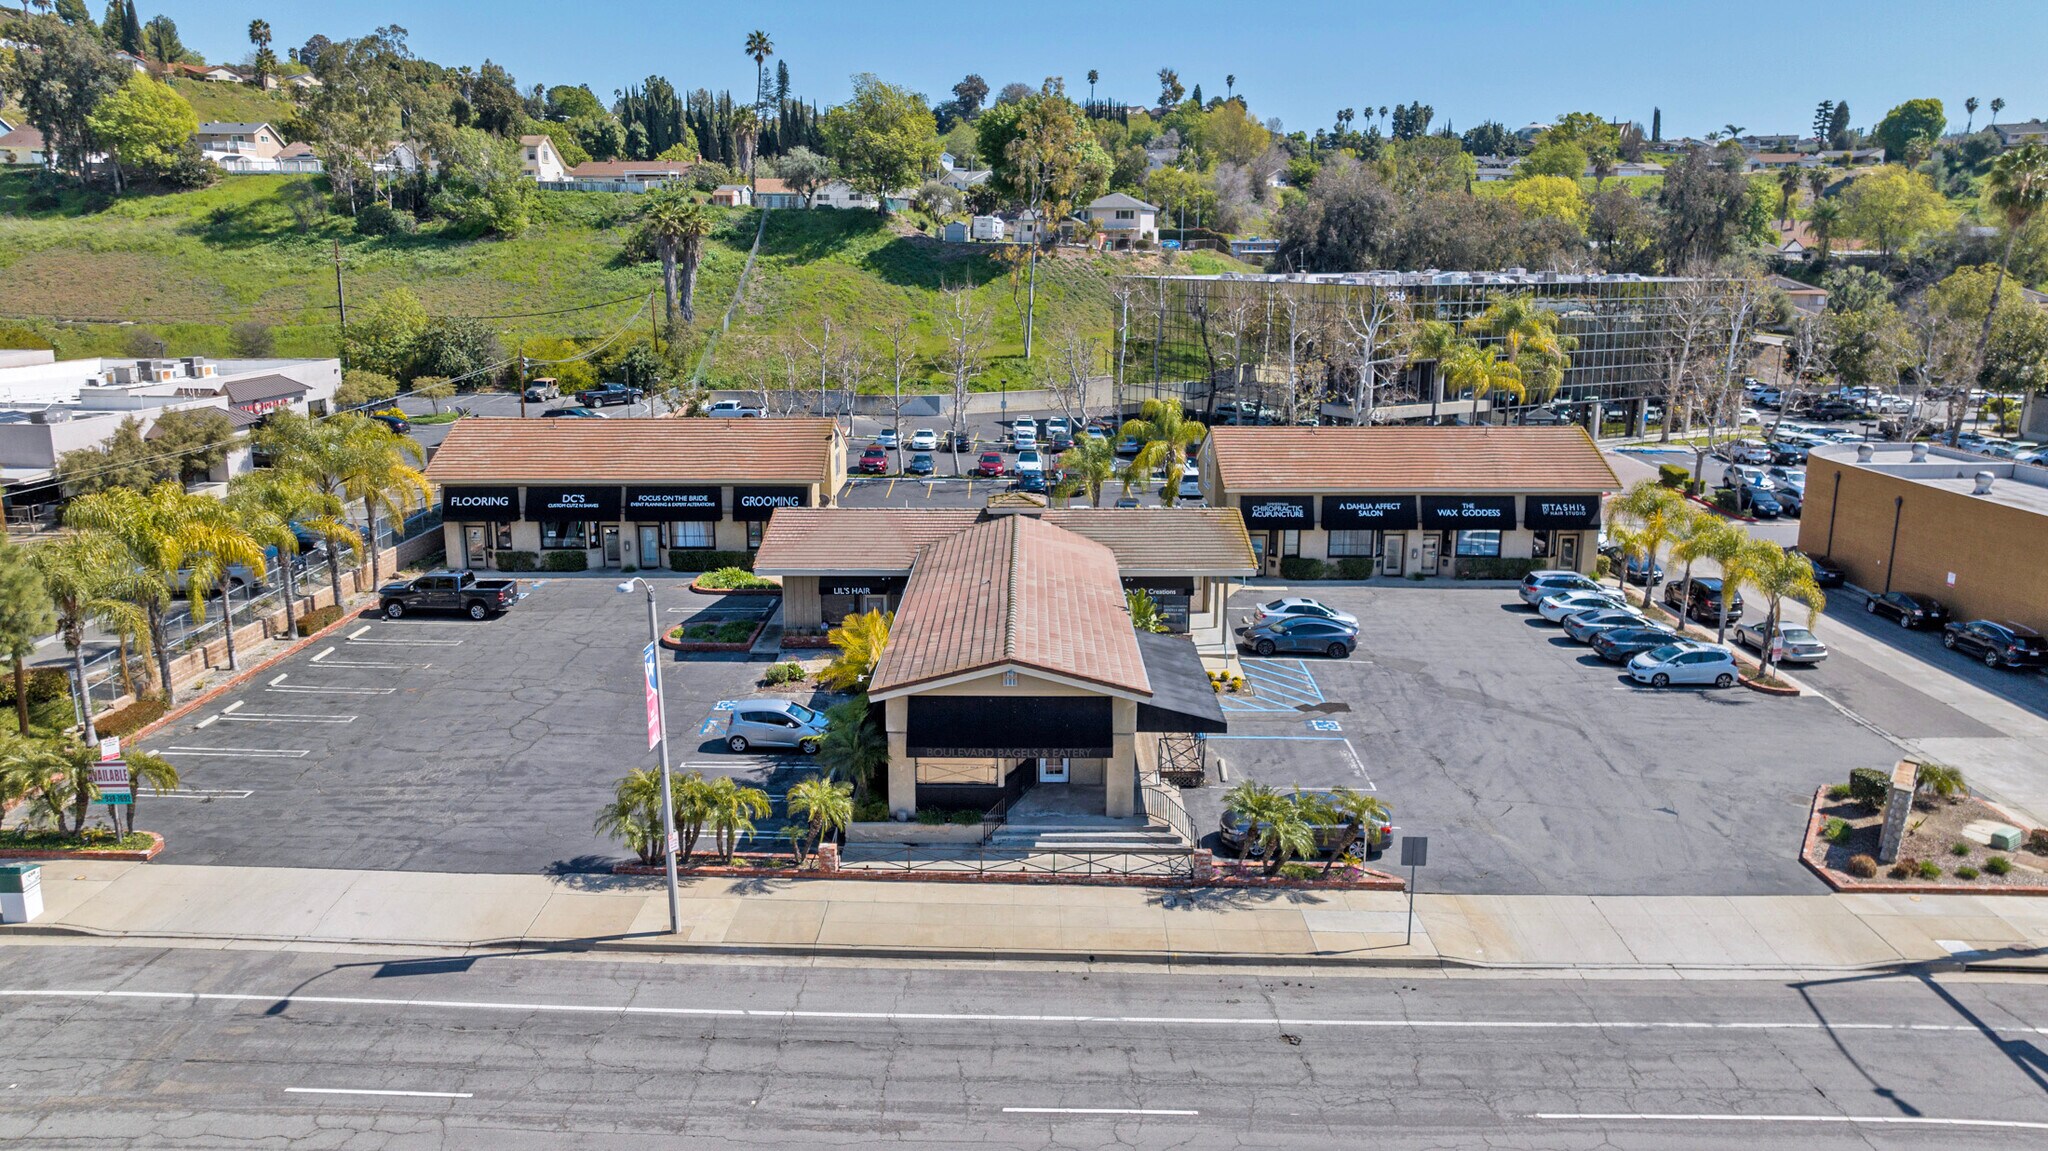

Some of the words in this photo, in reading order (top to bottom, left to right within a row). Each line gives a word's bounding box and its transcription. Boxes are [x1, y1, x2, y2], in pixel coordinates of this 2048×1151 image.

[450, 496, 509, 506] FLOORING
[562, 494, 585, 503] DC'S
[741, 496, 799, 507] GROOMING
[1550, 503, 1586, 511] TASHI's
[1437, 509, 1459, 517] WAX
[1462, 509, 1501, 517] GODDESS
[833, 587, 850, 595] LIL'S
[851, 587, 871, 595] HAIR
[926, 748, 995, 757] BOULEVARD
[997, 748, 1039, 757] BAGELS
[1041, 748, 1050, 757] &
[1052, 748, 1092, 757] EATERY
[88, 769, 128, 781] AVAILABLE
